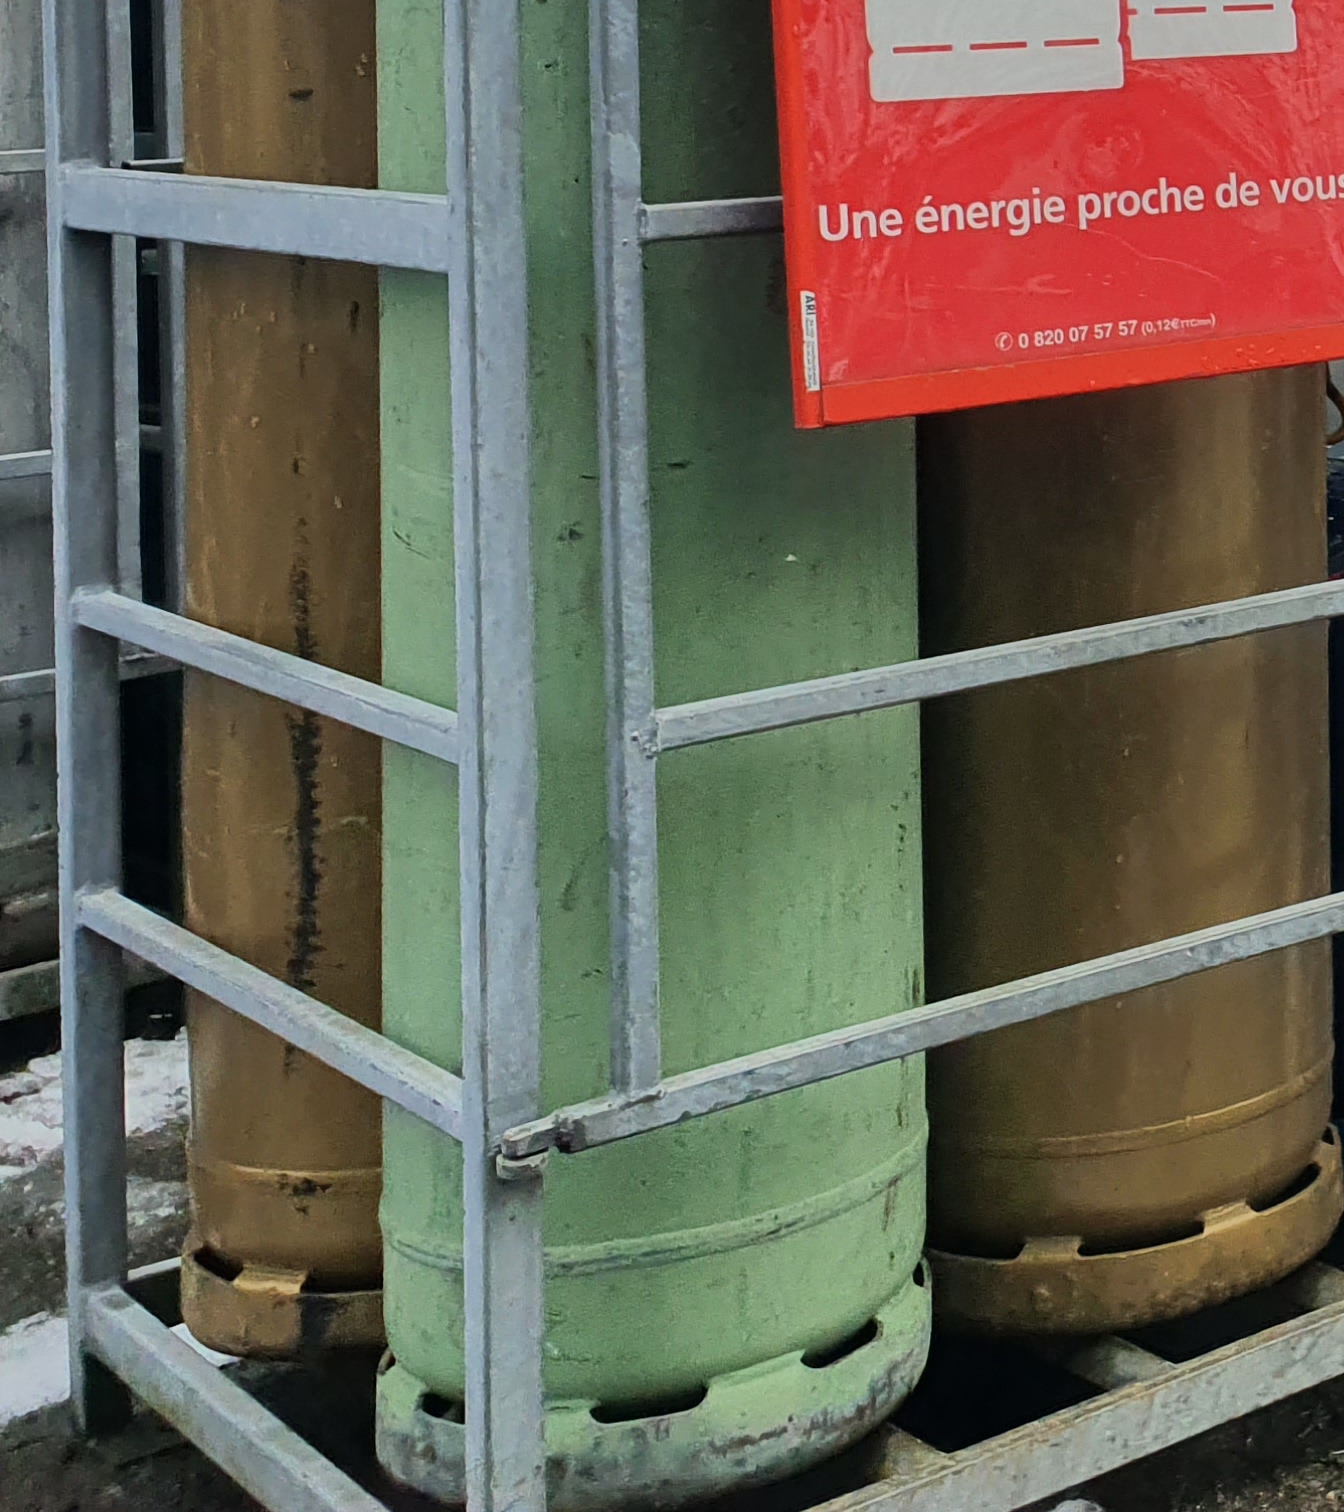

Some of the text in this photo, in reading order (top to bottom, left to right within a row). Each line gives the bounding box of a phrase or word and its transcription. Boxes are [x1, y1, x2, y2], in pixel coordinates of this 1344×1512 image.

[818, 203, 903, 242] Une
[915, 187, 1065, 236] énergie
[1077, 177, 1204, 231] proche
[1216, 172, 1259, 210] de
[1018, 333, 1029, 349] 0
[1034, 329, 1064, 347] 820
[1069, 326, 1089, 342] 07
[1094, 322, 1113, 339] 57
[1118, 319, 1138, 336] 57
